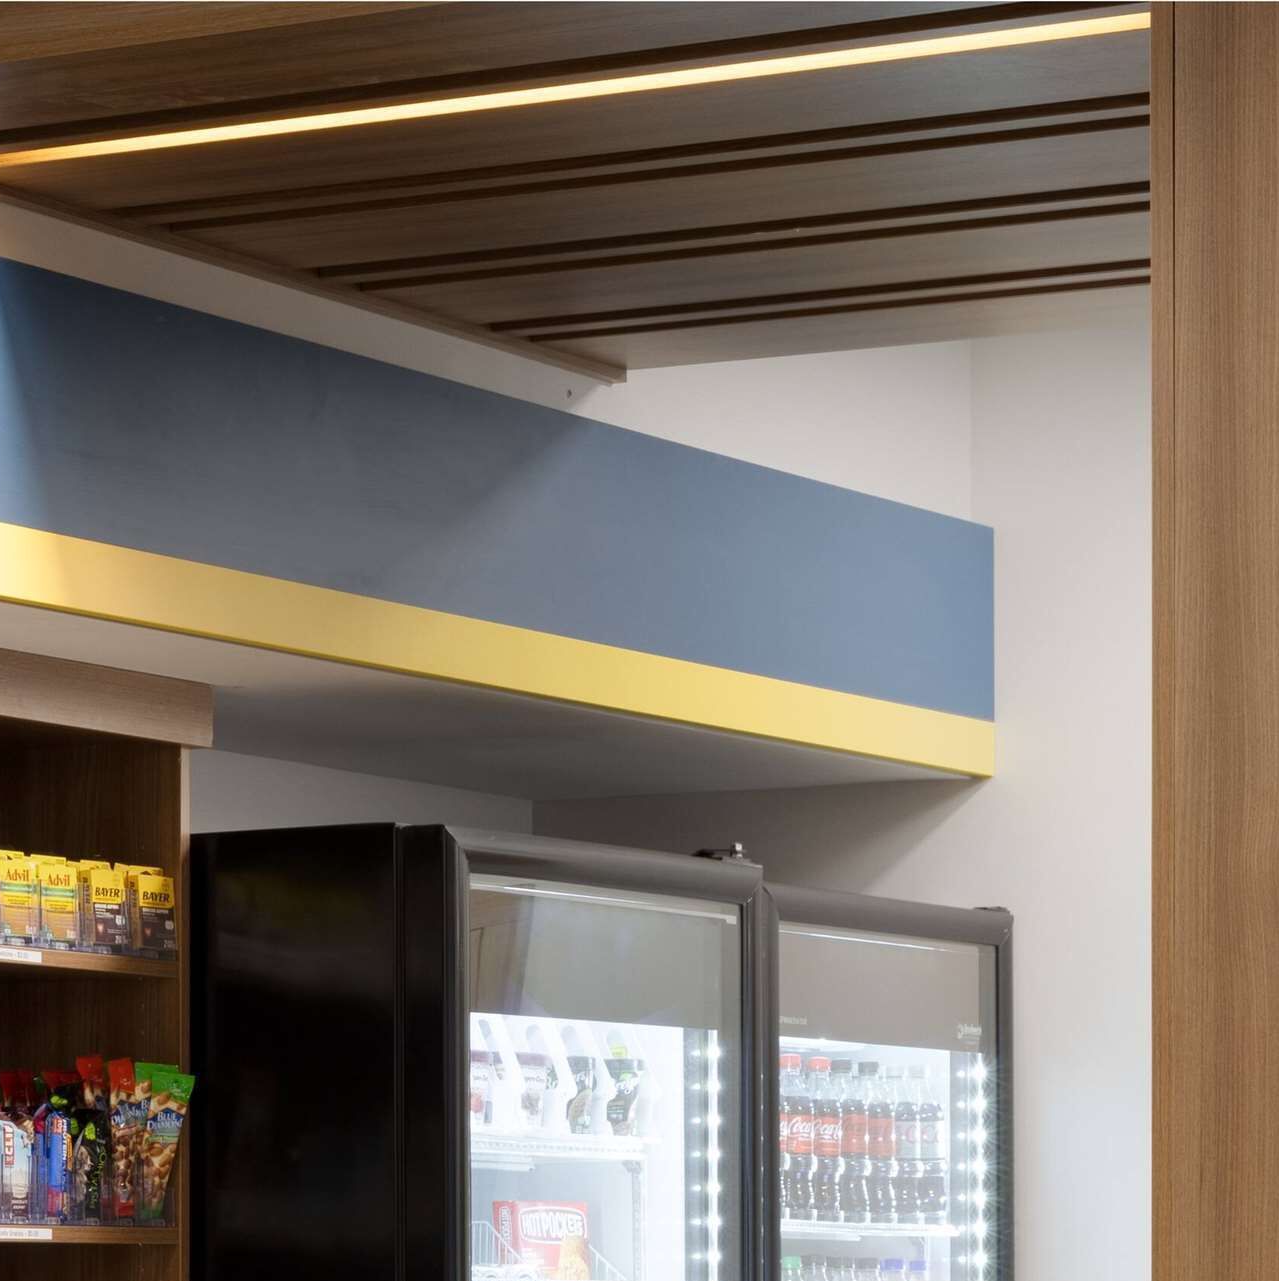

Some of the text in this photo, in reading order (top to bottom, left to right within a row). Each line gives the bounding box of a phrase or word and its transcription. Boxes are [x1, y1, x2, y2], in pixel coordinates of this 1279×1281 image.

[6, 868, 29, 882] Advil
[48, 874, 70, 887] Advil
[95, 886, 120, 898] BAYER
[142, 891, 170, 903] BAYER
[157, 1111, 176, 1121] BLUE
